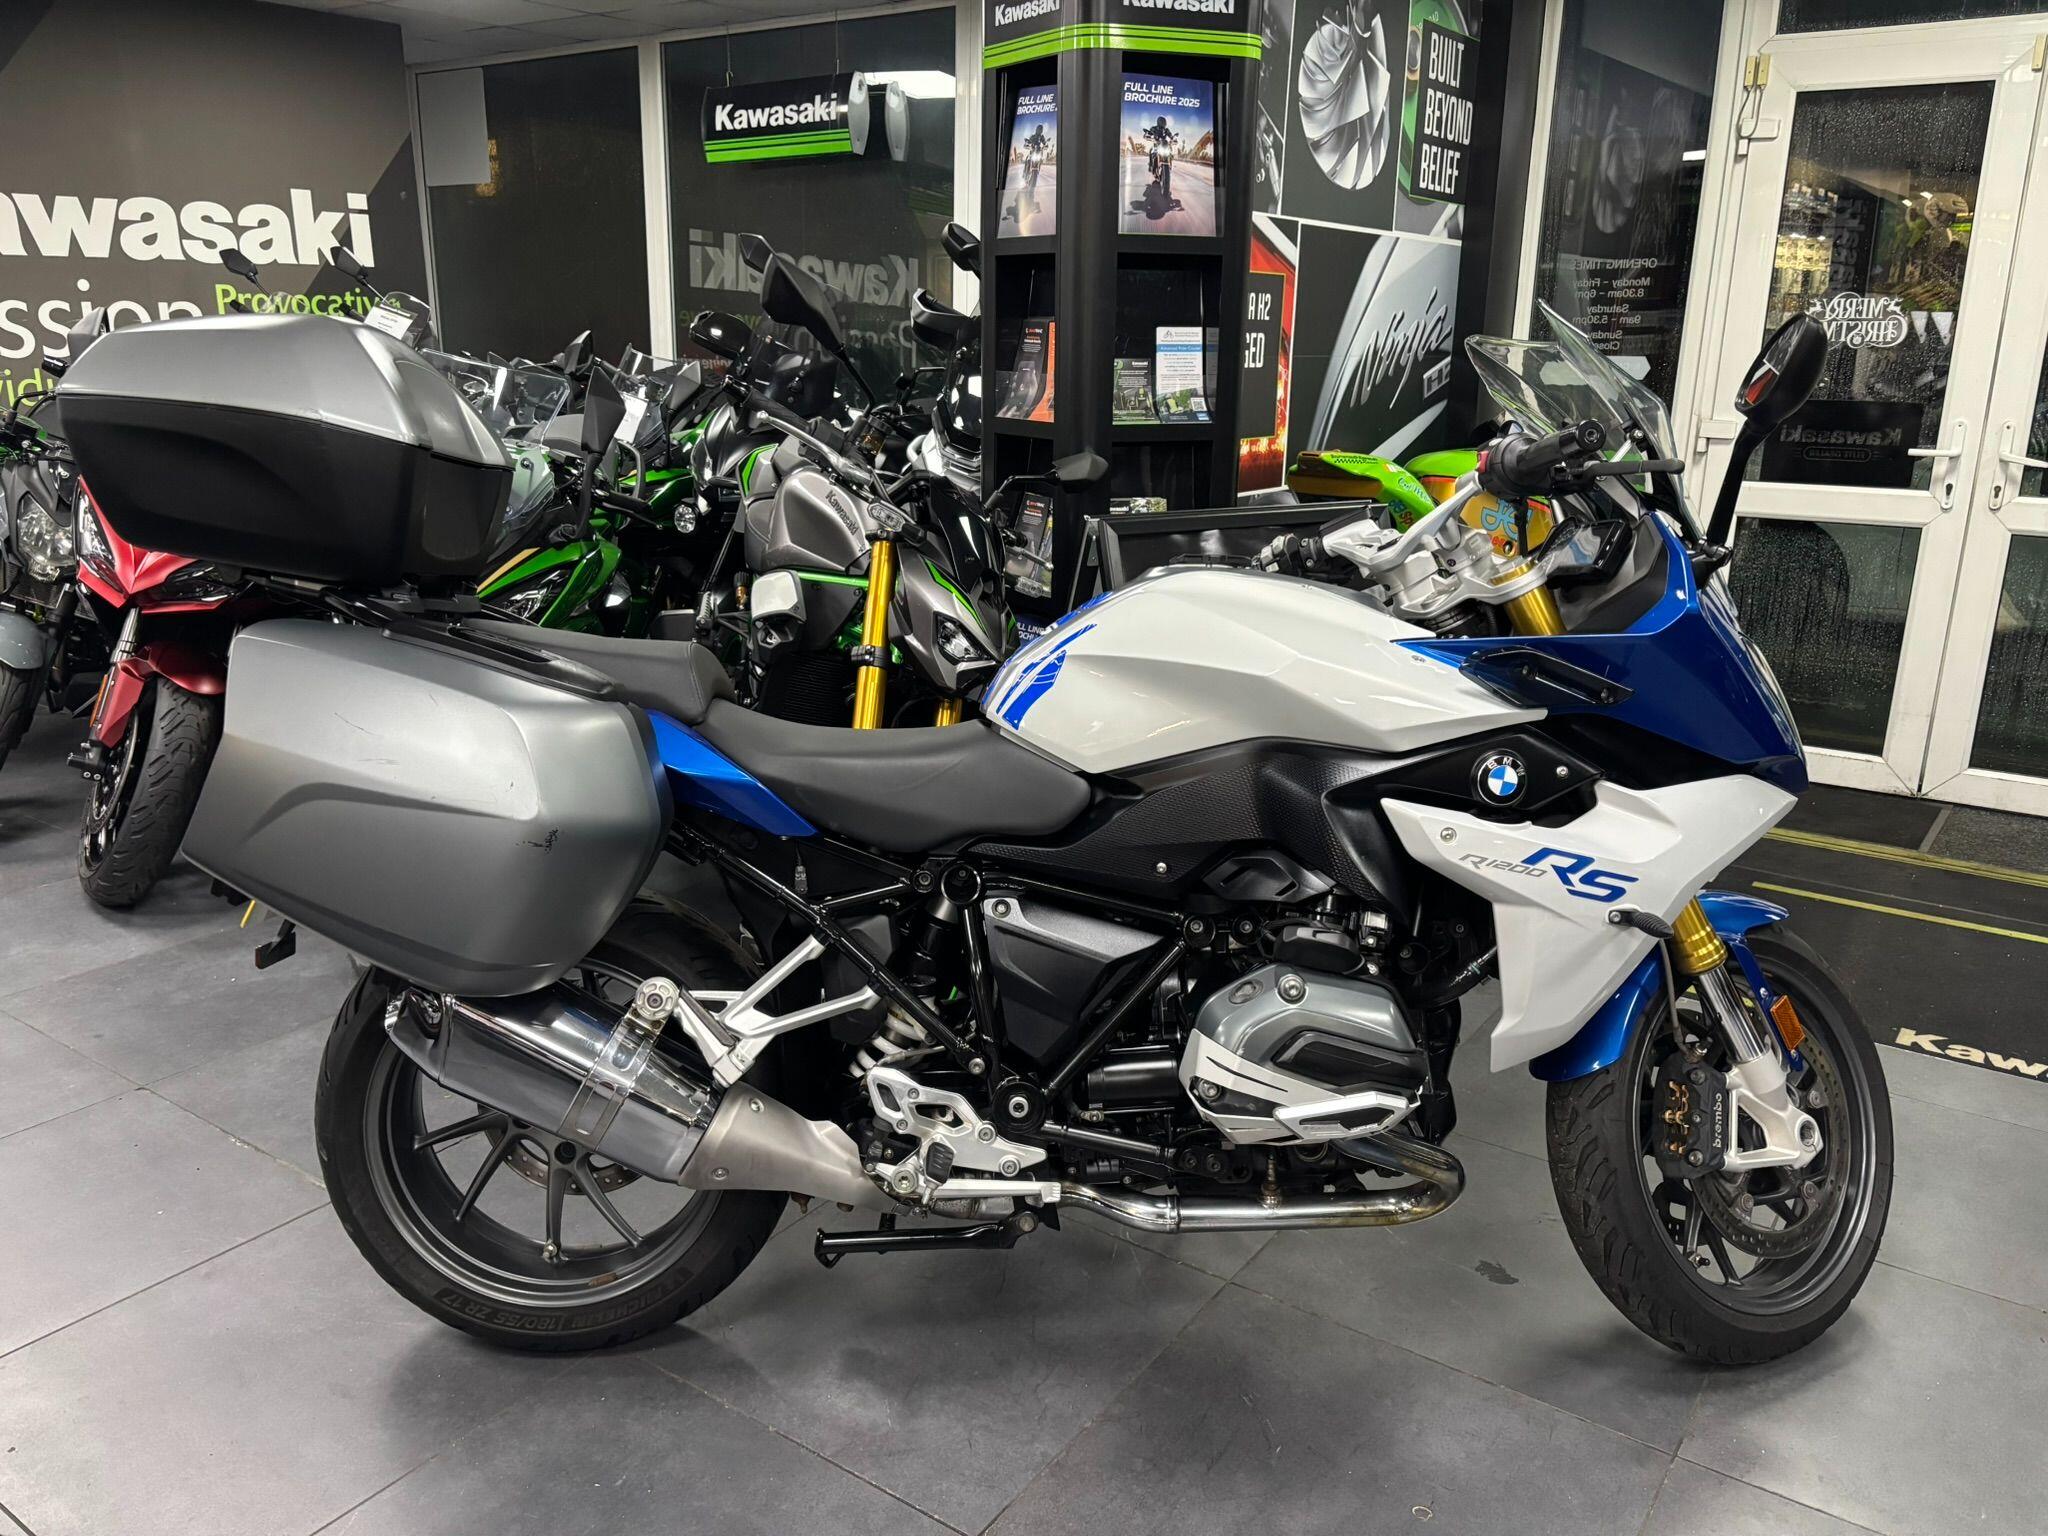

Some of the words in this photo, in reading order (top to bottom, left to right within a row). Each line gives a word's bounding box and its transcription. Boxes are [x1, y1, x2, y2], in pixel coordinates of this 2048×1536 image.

[1428, 32, 1465, 90] BUILT
[1018, 94, 1035, 105] FULL
[1036, 93, 1054, 104] LINE
[1124, 81, 1149, 93] FULL
[1152, 84, 1174, 95] LINE
[1124, 91, 1178, 106] BROCHURE
[1178, 97, 1201, 108] 2025
[715, 93, 838, 131] Kawasaki
[1017, 104, 1055, 115] BROCHURE
[1424, 87, 1473, 146] BEYOND
[1419, 143, 1461, 195] BELIEF
[1257, 292, 1272, 321] H2
[1350, 287, 1452, 410] Ninja
[824, 490, 859, 537] Kawasaki
[1486, 756, 1526, 777] BMW
[1459, 853, 1548, 879] R1200
[1520, 847, 1640, 903] RS
[1712, 1092, 1724, 1148] brembo
[441, 1293, 465, 1309] 17
[493, 1312, 557, 1330] 180/55
